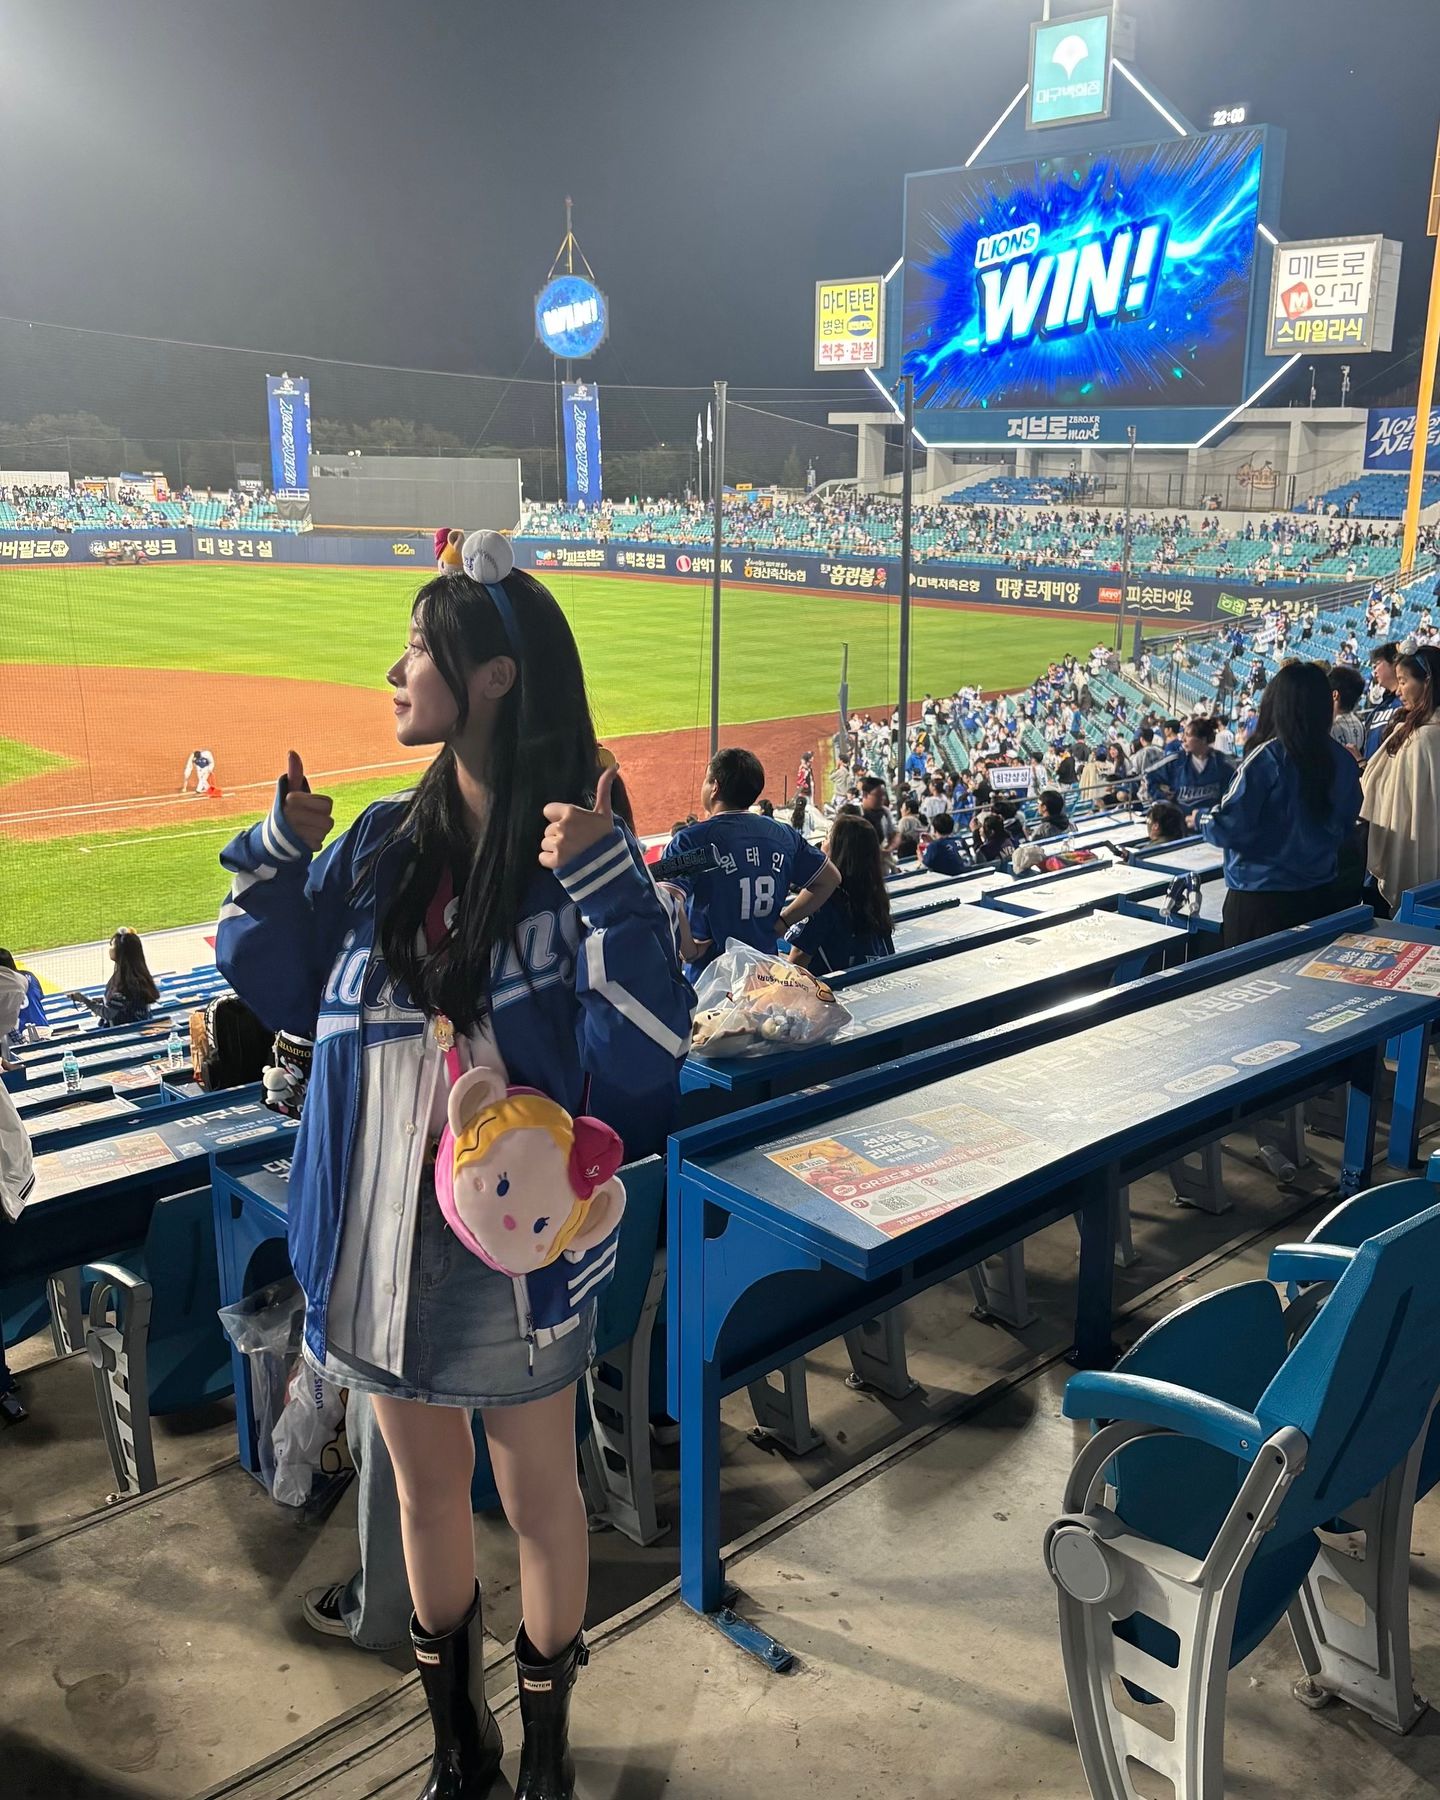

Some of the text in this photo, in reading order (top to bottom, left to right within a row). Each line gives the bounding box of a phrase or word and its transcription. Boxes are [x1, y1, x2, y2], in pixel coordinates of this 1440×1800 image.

[1213, 107, 1246, 127] 22:00
[979, 228, 1036, 263] LIONS
[1288, 251, 1366, 279] 메트로
[981, 225, 1161, 346] WIN!
[1289, 281, 1363, 313] M 안과
[823, 319, 844, 335] 병원
[1276, 317, 1364, 343] 스마일라식
[197, 537, 273, 558] 대방건설
[739, 875, 775, 921] 18
[315, 1378, 324, 1410] LIONS
[524, 1679, 551, 1690] HUNTER
